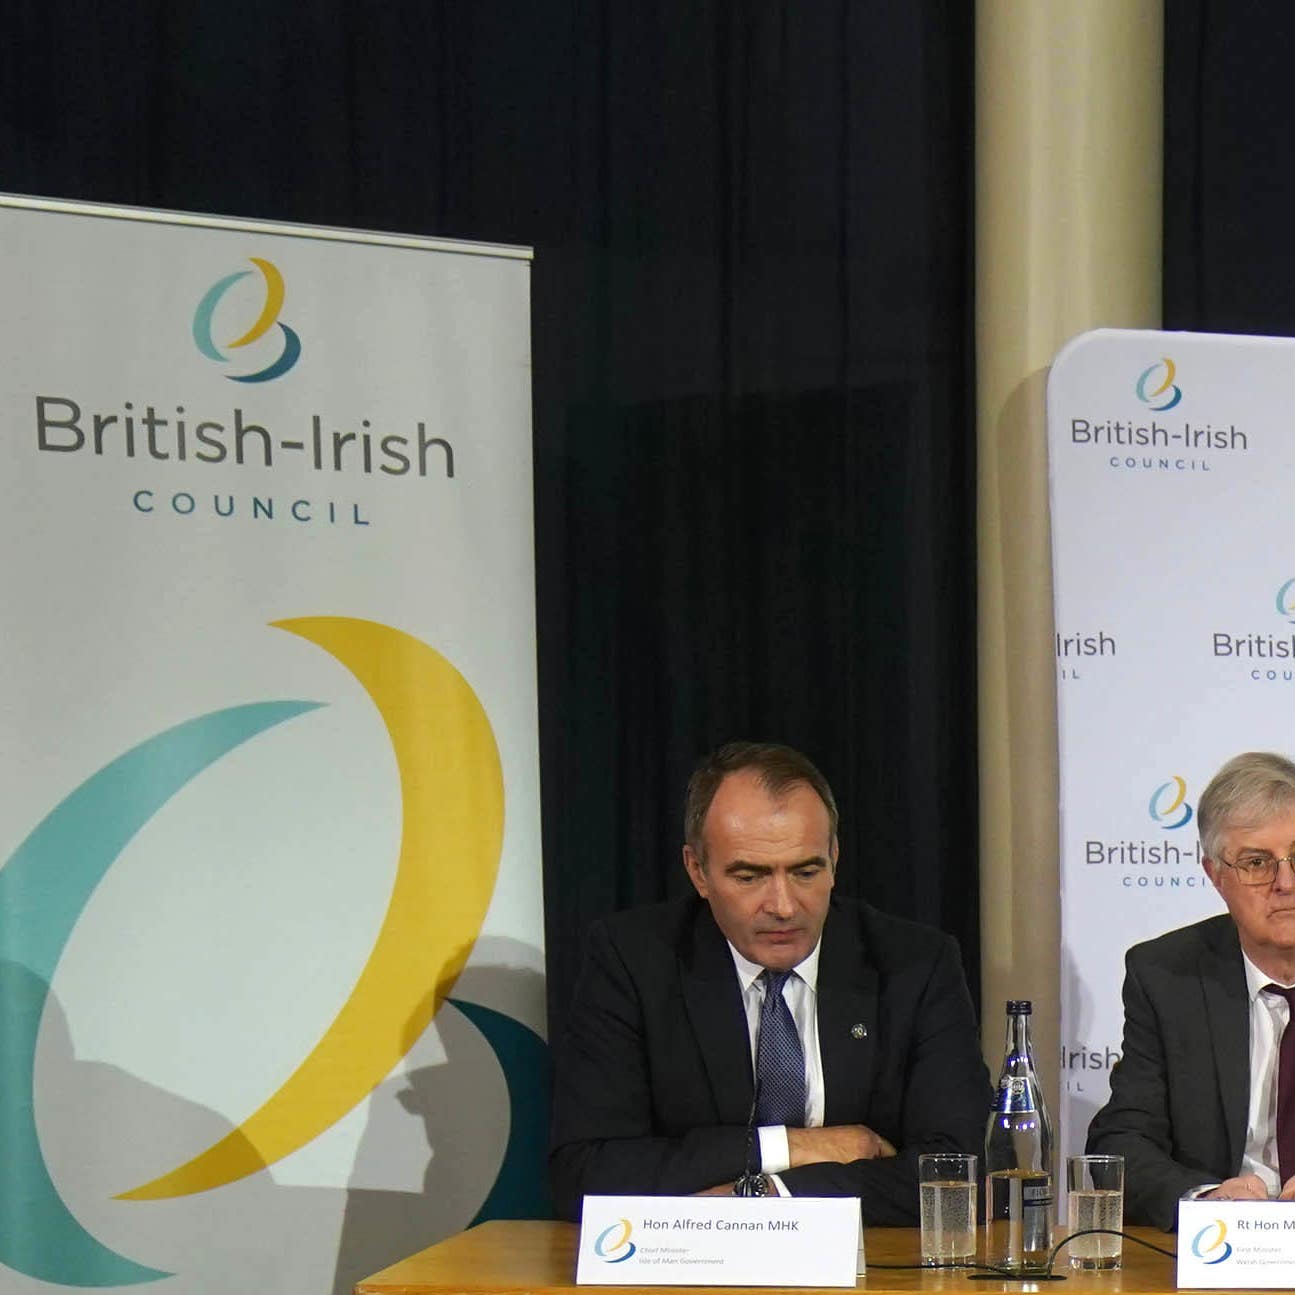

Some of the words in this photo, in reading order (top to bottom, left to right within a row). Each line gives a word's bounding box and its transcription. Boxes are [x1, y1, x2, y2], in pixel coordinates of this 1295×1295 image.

[35, 395, 455, 479] British-Irish
[1070, 418, 1248, 451] British-Irish
[1109, 456, 1211, 472] COUNCIL
[133, 489, 370, 525] COUNCIL
[1085, 840, 1201, 865] British-I
[1122, 876, 1207, 888] COUNCI
[643, 1219, 669, 1231] Hon
[673, 1218, 712, 1231] Alfred
[715, 1219, 764, 1232] Cannan
[768, 1220, 799, 1232] MHK
[1237, 1219, 1250, 1231] Rt
[1253, 1220, 1279, 1231] Hon
